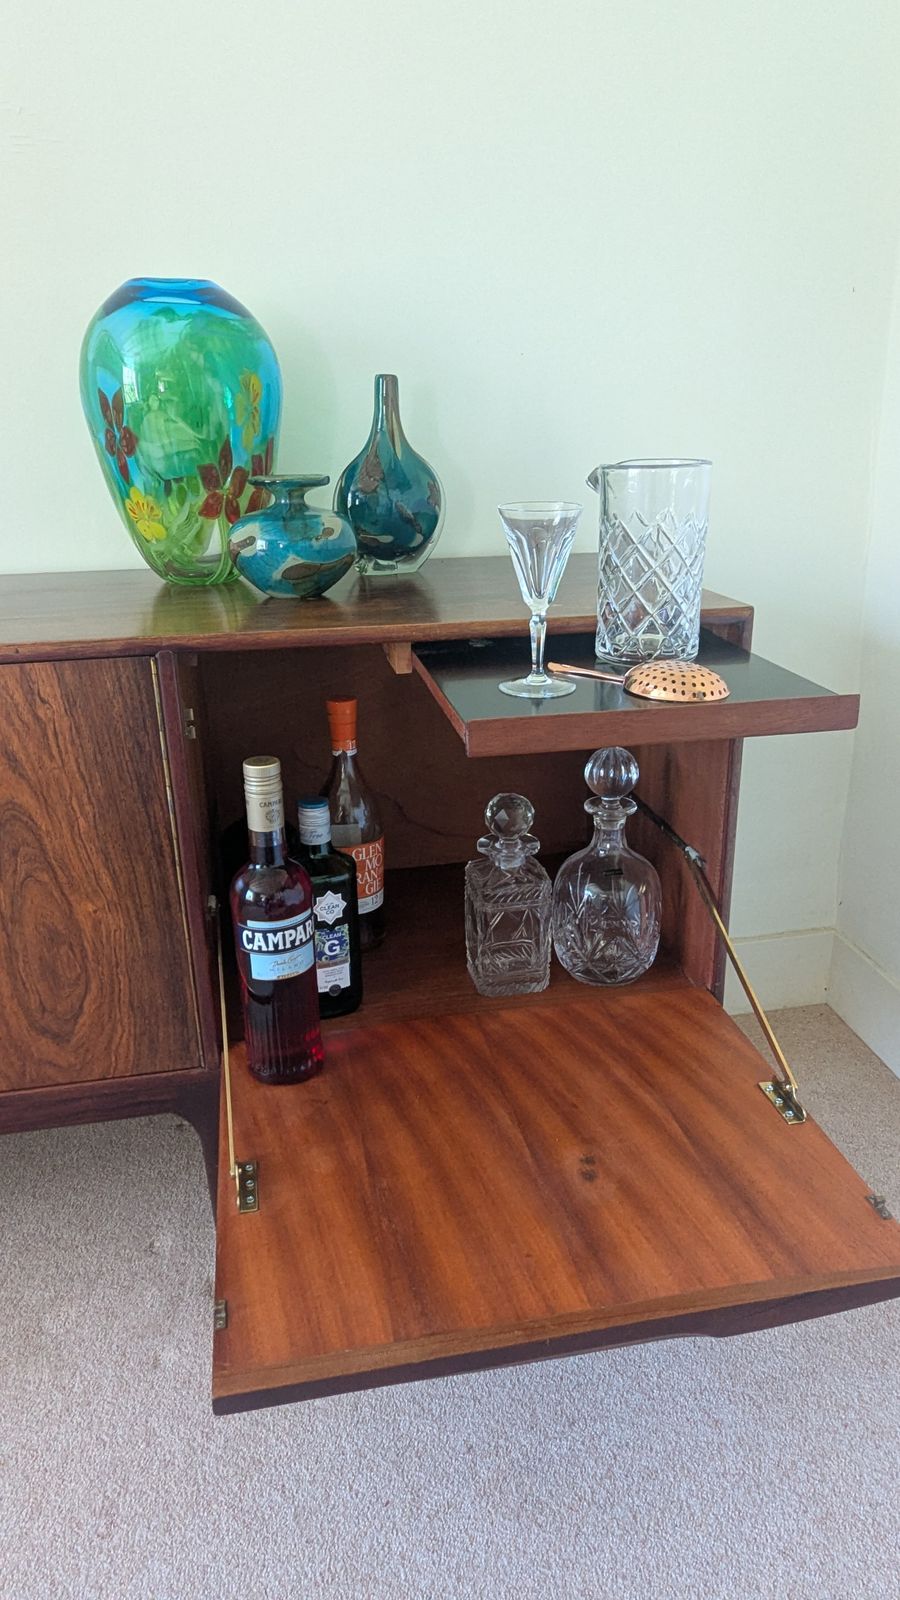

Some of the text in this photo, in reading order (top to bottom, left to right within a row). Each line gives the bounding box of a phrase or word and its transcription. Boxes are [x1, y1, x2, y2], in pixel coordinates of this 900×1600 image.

[352, 842, 382, 862] GLEN
[365, 853, 383, 872] MO
[320, 903, 340, 912] CLEAN
[371, 894, 379, 906] 12
[324, 939, 341, 956] G
